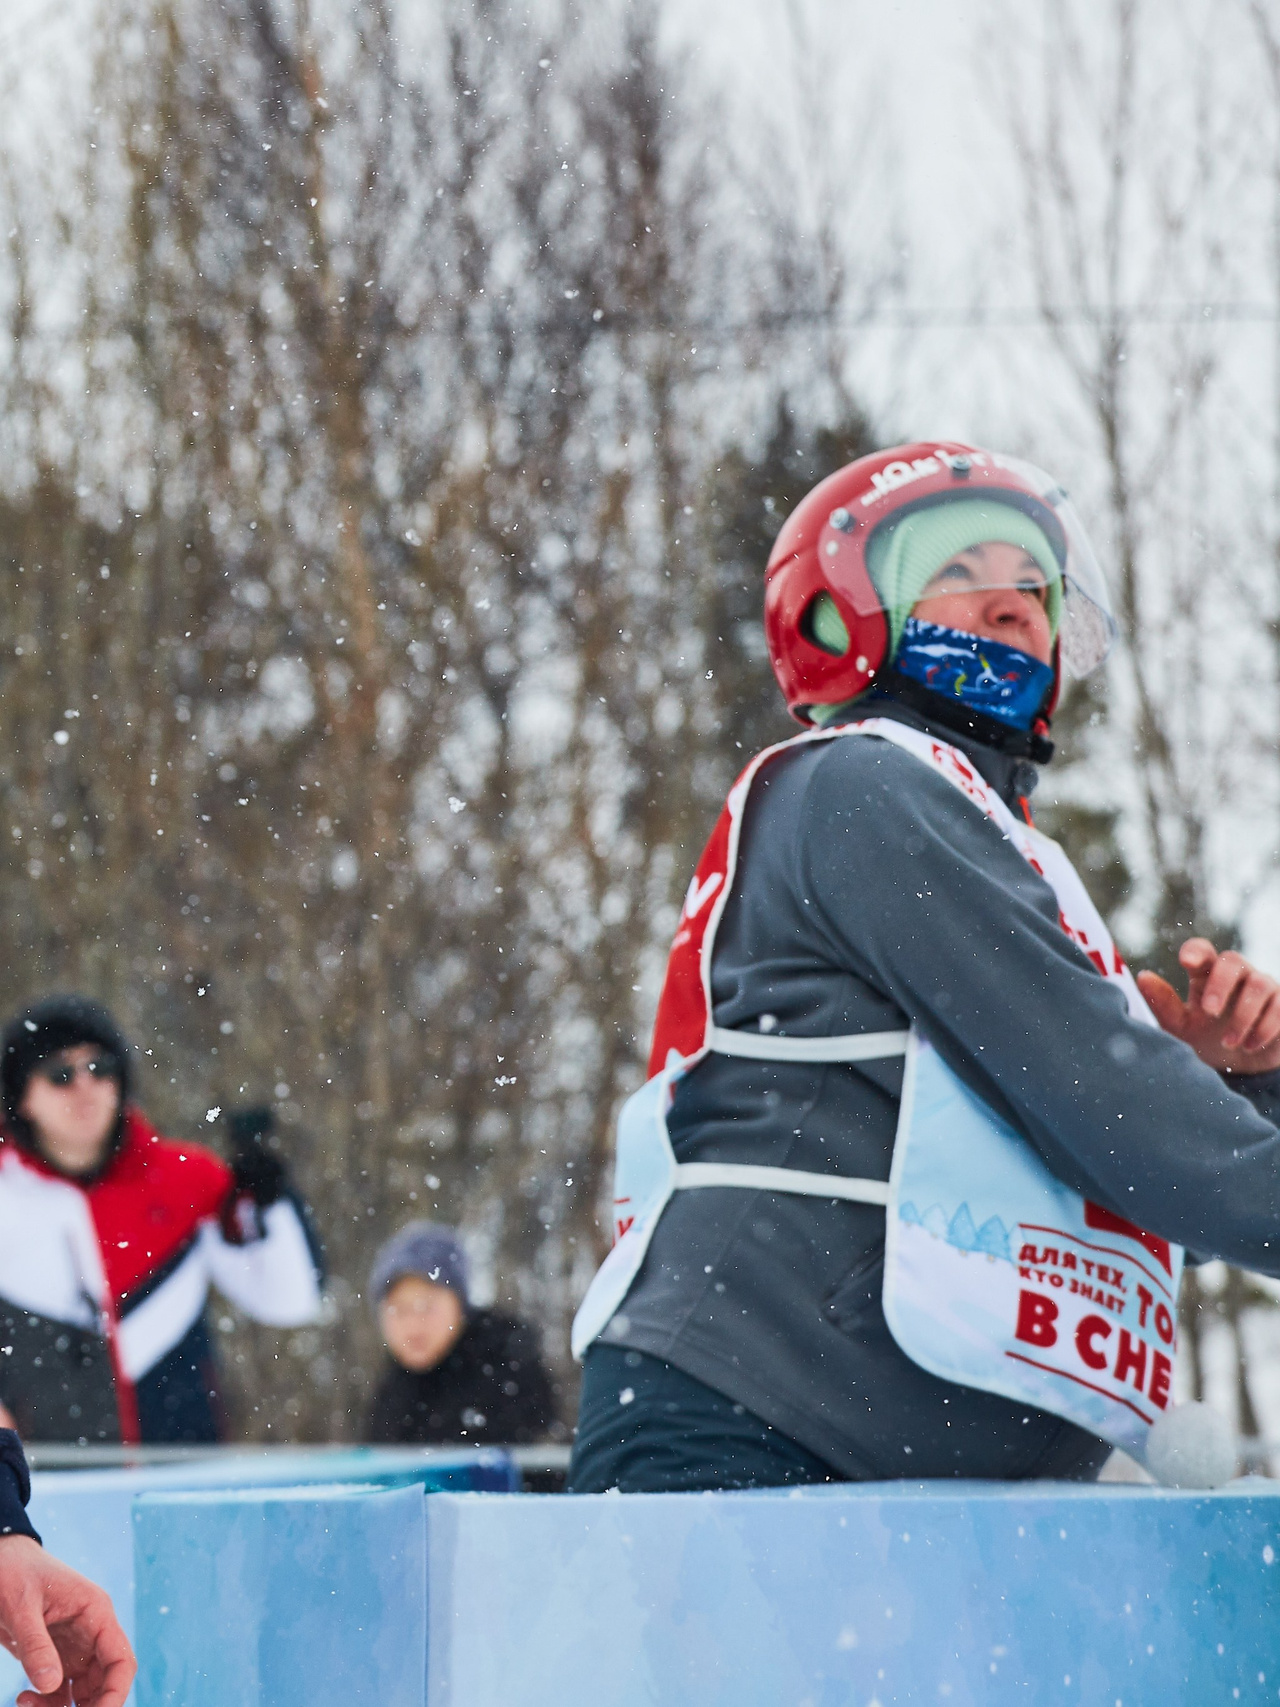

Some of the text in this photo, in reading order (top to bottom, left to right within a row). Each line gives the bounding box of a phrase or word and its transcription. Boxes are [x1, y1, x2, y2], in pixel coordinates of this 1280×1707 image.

[1018, 1243, 1077, 1271] ДЛЯ
[1017, 1266, 1126, 1315] КТО ЗНАЕТ
[1136, 1282, 1177, 1354] ТО
[1015, 1288, 1173, 1411] В СНЕ
